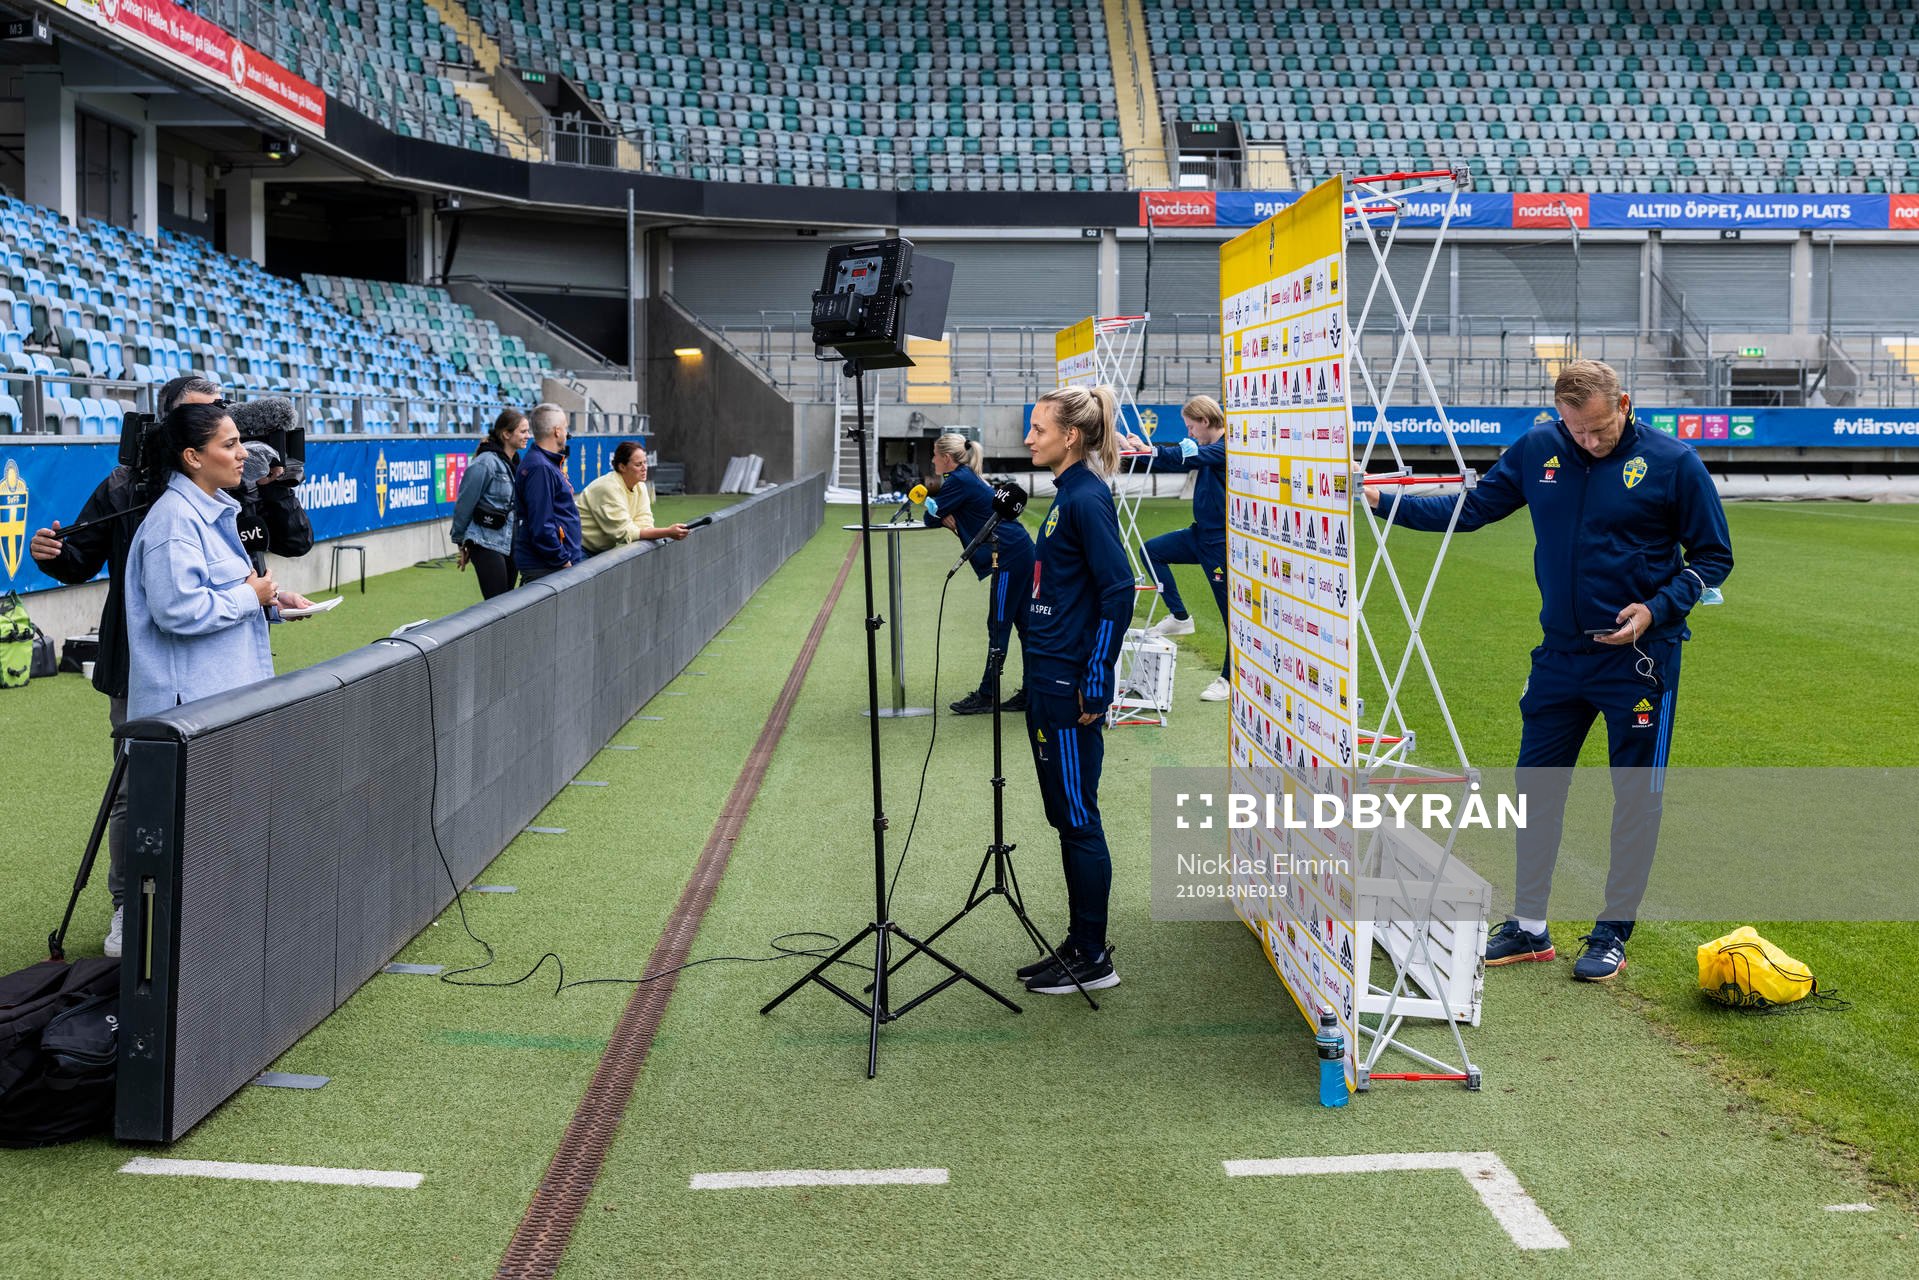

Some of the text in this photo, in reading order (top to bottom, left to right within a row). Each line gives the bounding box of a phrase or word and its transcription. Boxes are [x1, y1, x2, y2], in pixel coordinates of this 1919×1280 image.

[9, 24, 23, 35] M3
[1147, 201, 1210, 215] nordstan
[1518, 202, 1583, 217] nordstan
[1627, 200, 1851, 221] ALLTID ÖPPET, ALLTID PLATS
[389, 460, 429, 482] FOTBOLLEN
[389, 481, 429, 509] SAMHÄLLET
[995, 488, 1010, 503] svt
[240, 526, 264, 541] svt
[1036, 604, 1052, 615] SPEL
